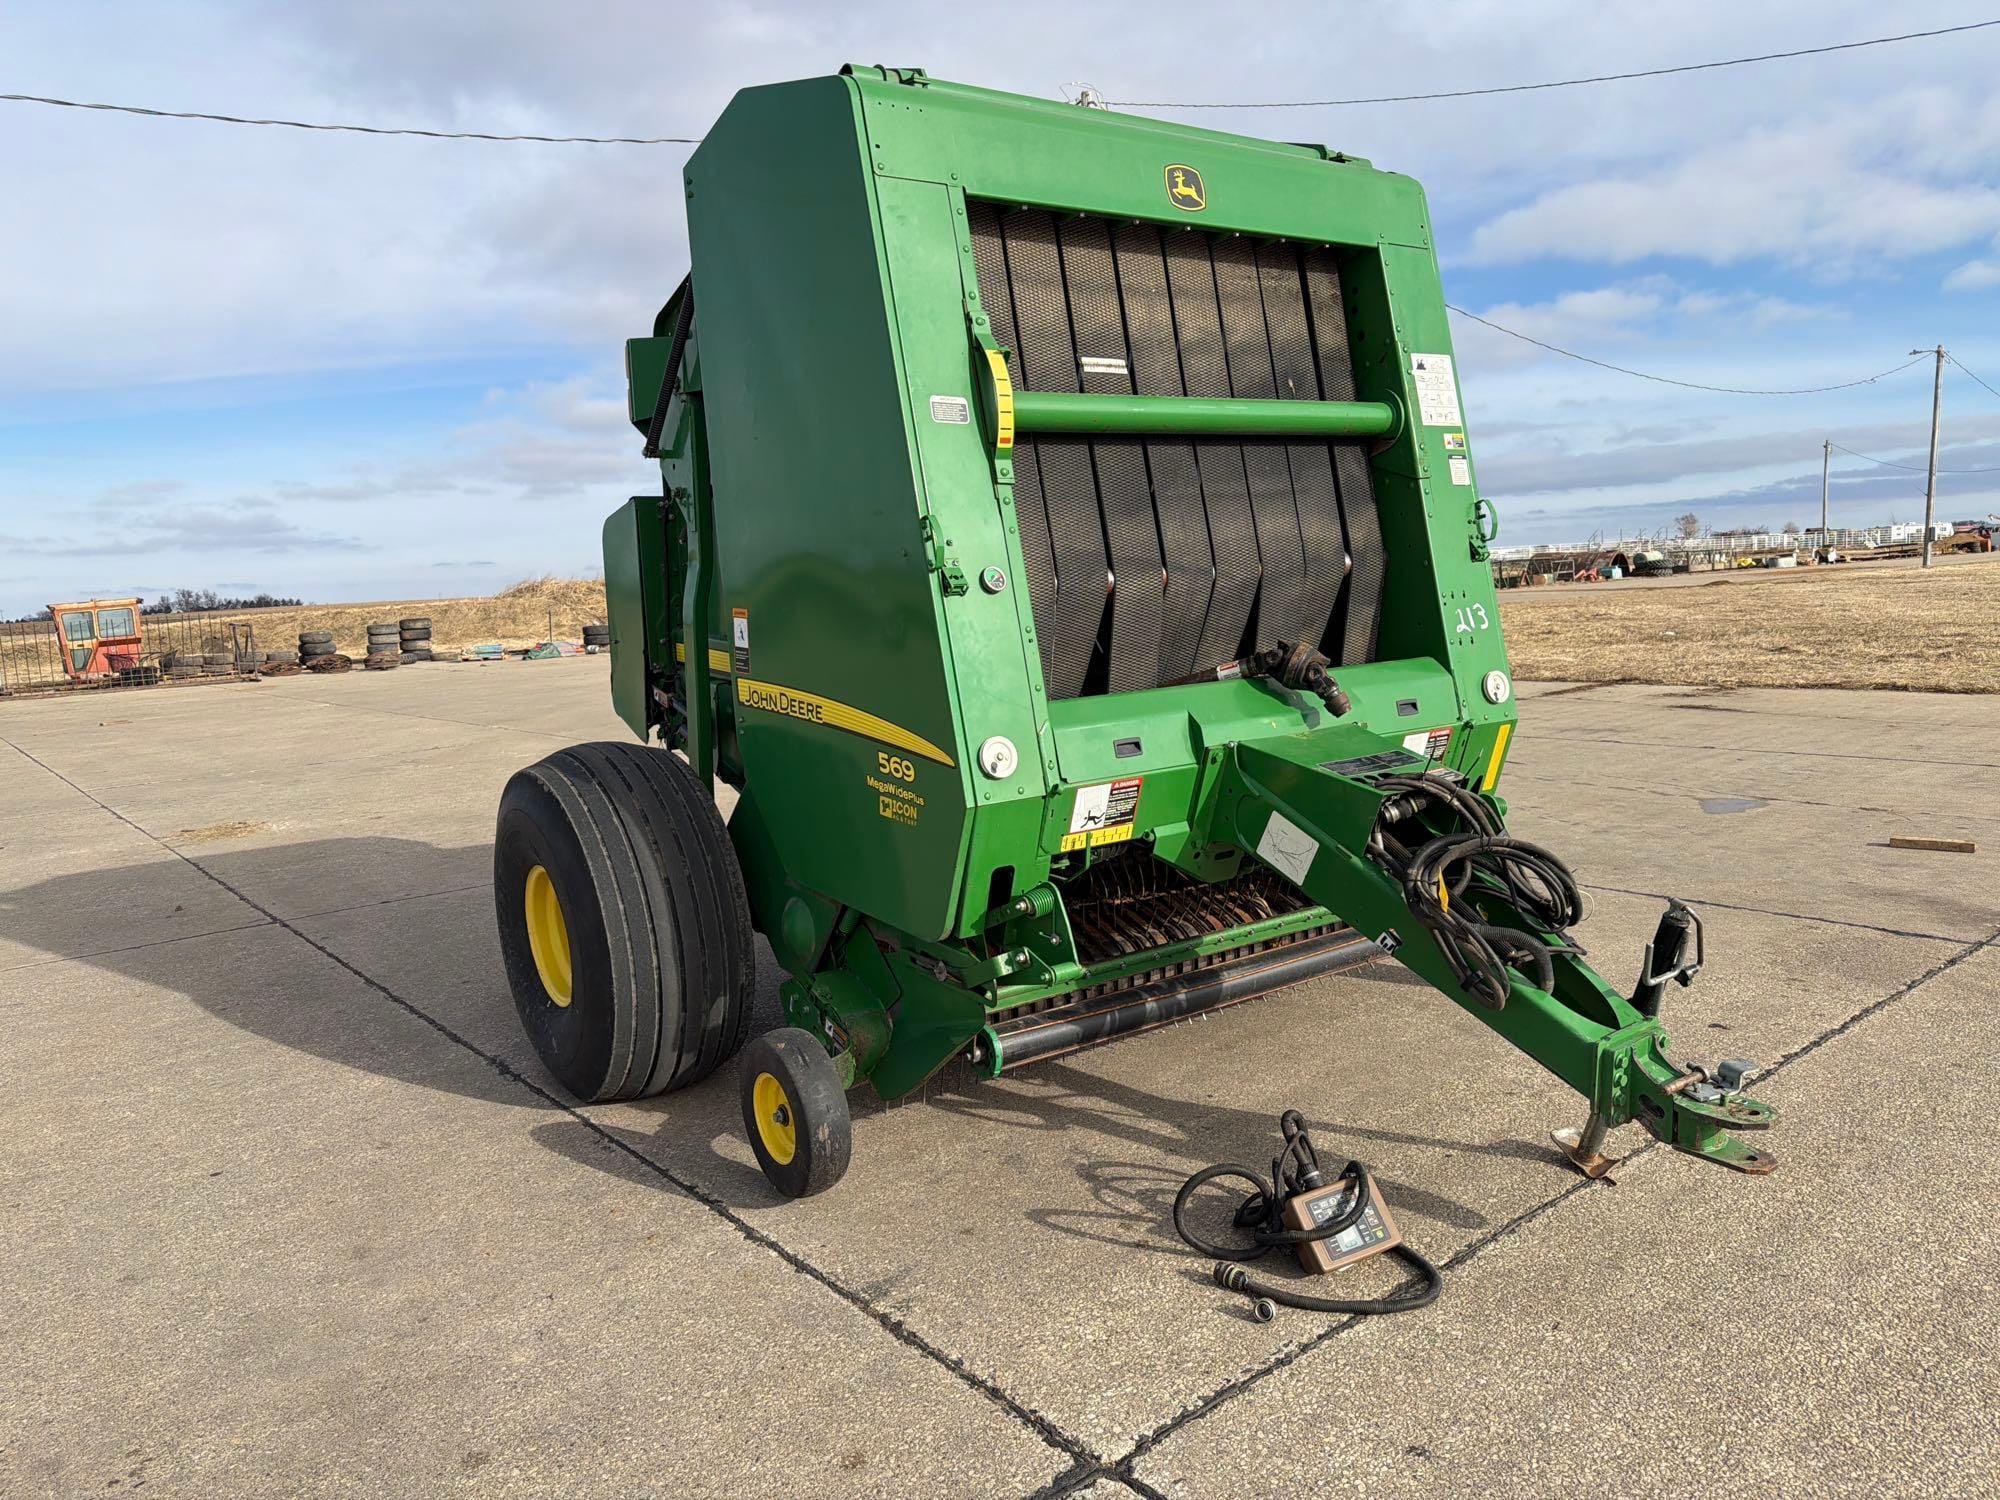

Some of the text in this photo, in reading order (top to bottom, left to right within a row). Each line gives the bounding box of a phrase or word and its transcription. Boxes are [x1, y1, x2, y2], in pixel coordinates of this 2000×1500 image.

[745, 685, 823, 721] JOHN DEERE
[877, 751, 915, 782] 569
[867, 775, 925, 806] MegaWidePlus
[892, 800, 917, 819] ICON
